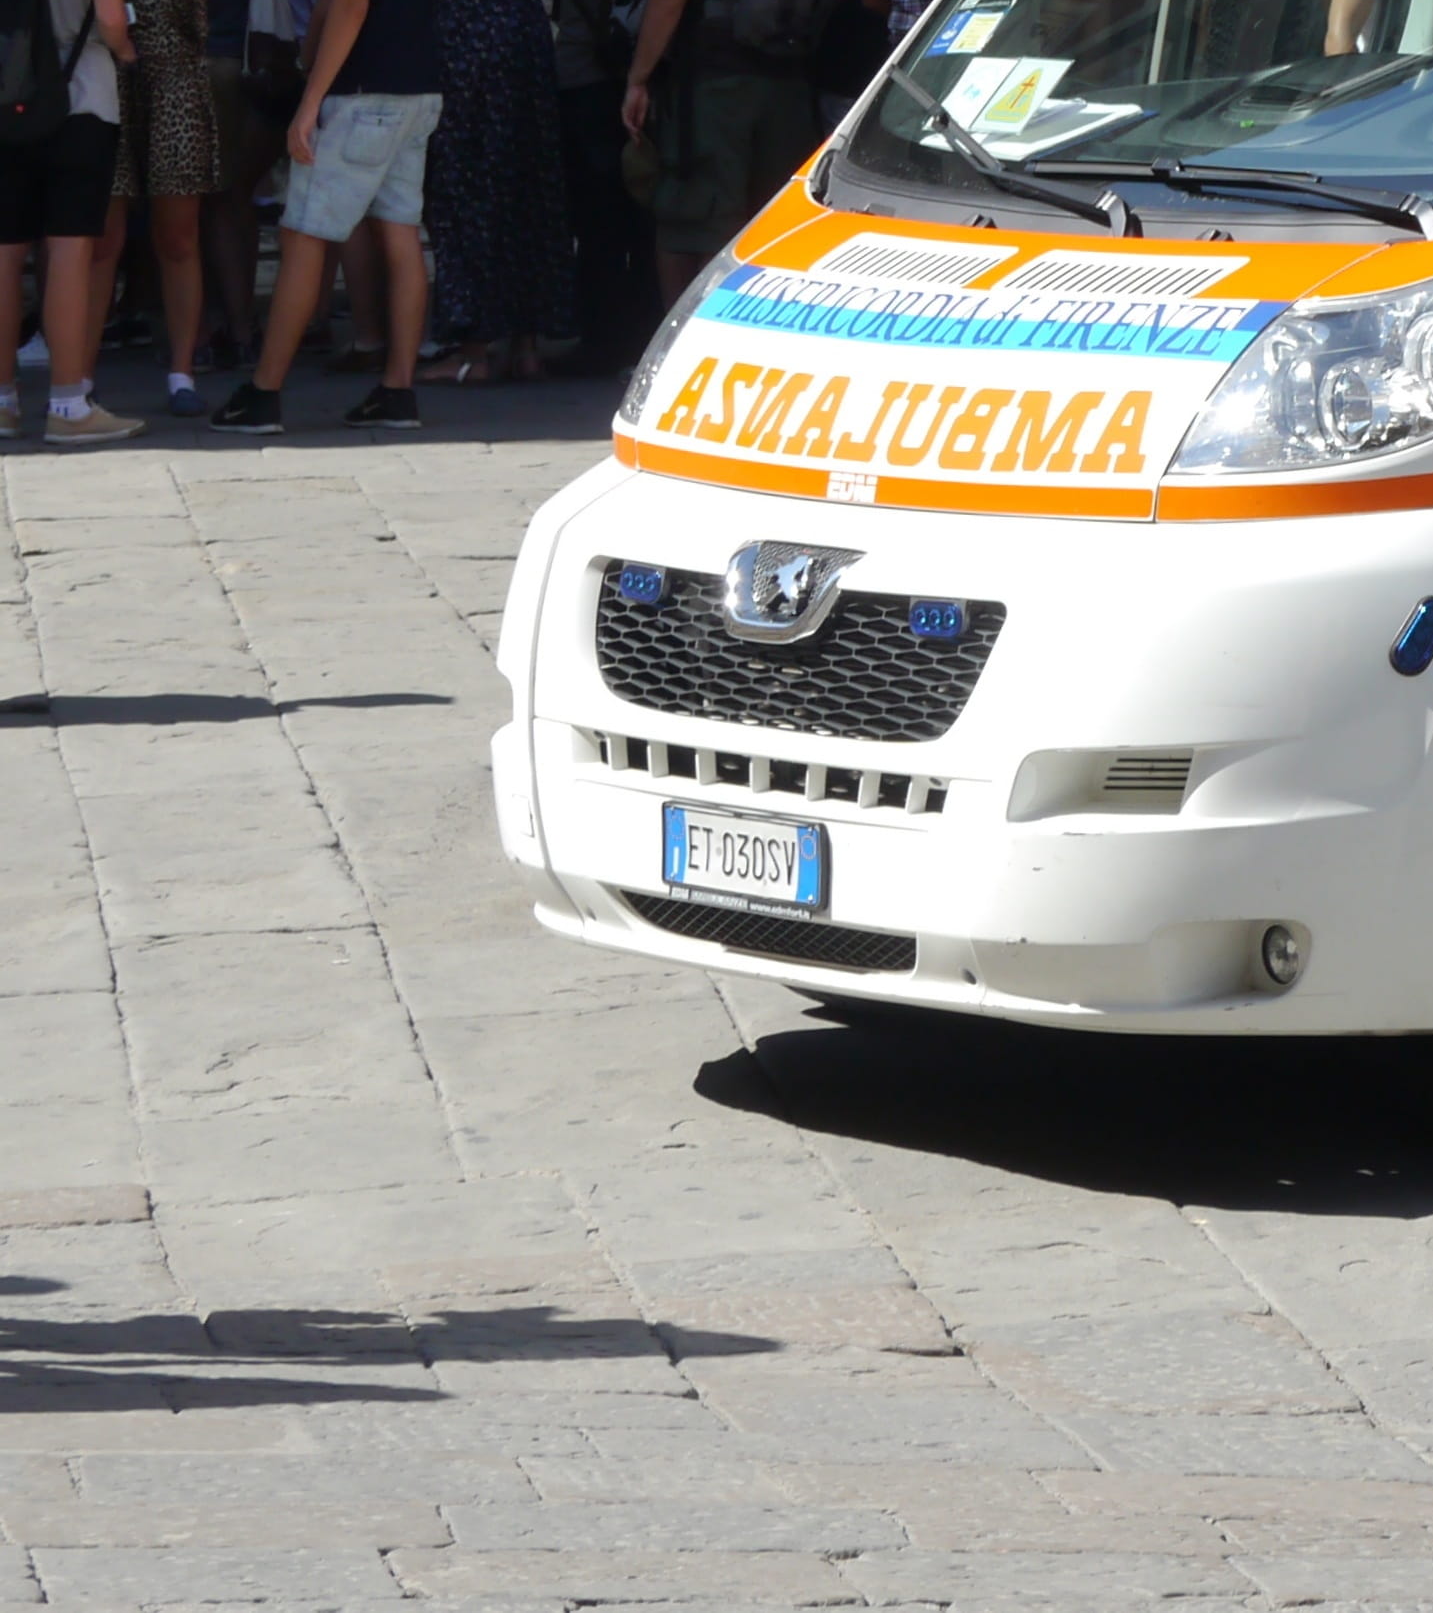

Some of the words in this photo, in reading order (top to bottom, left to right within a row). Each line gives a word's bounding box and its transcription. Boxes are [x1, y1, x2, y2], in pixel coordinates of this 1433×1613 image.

[715, 273, 990, 345] MISERICORDIA
[972, 294, 1041, 346] di
[1018, 299, 1247, 356] FIRENZE
[687, 824, 714, 872] ET
[722, 831, 796, 887] 030SV
